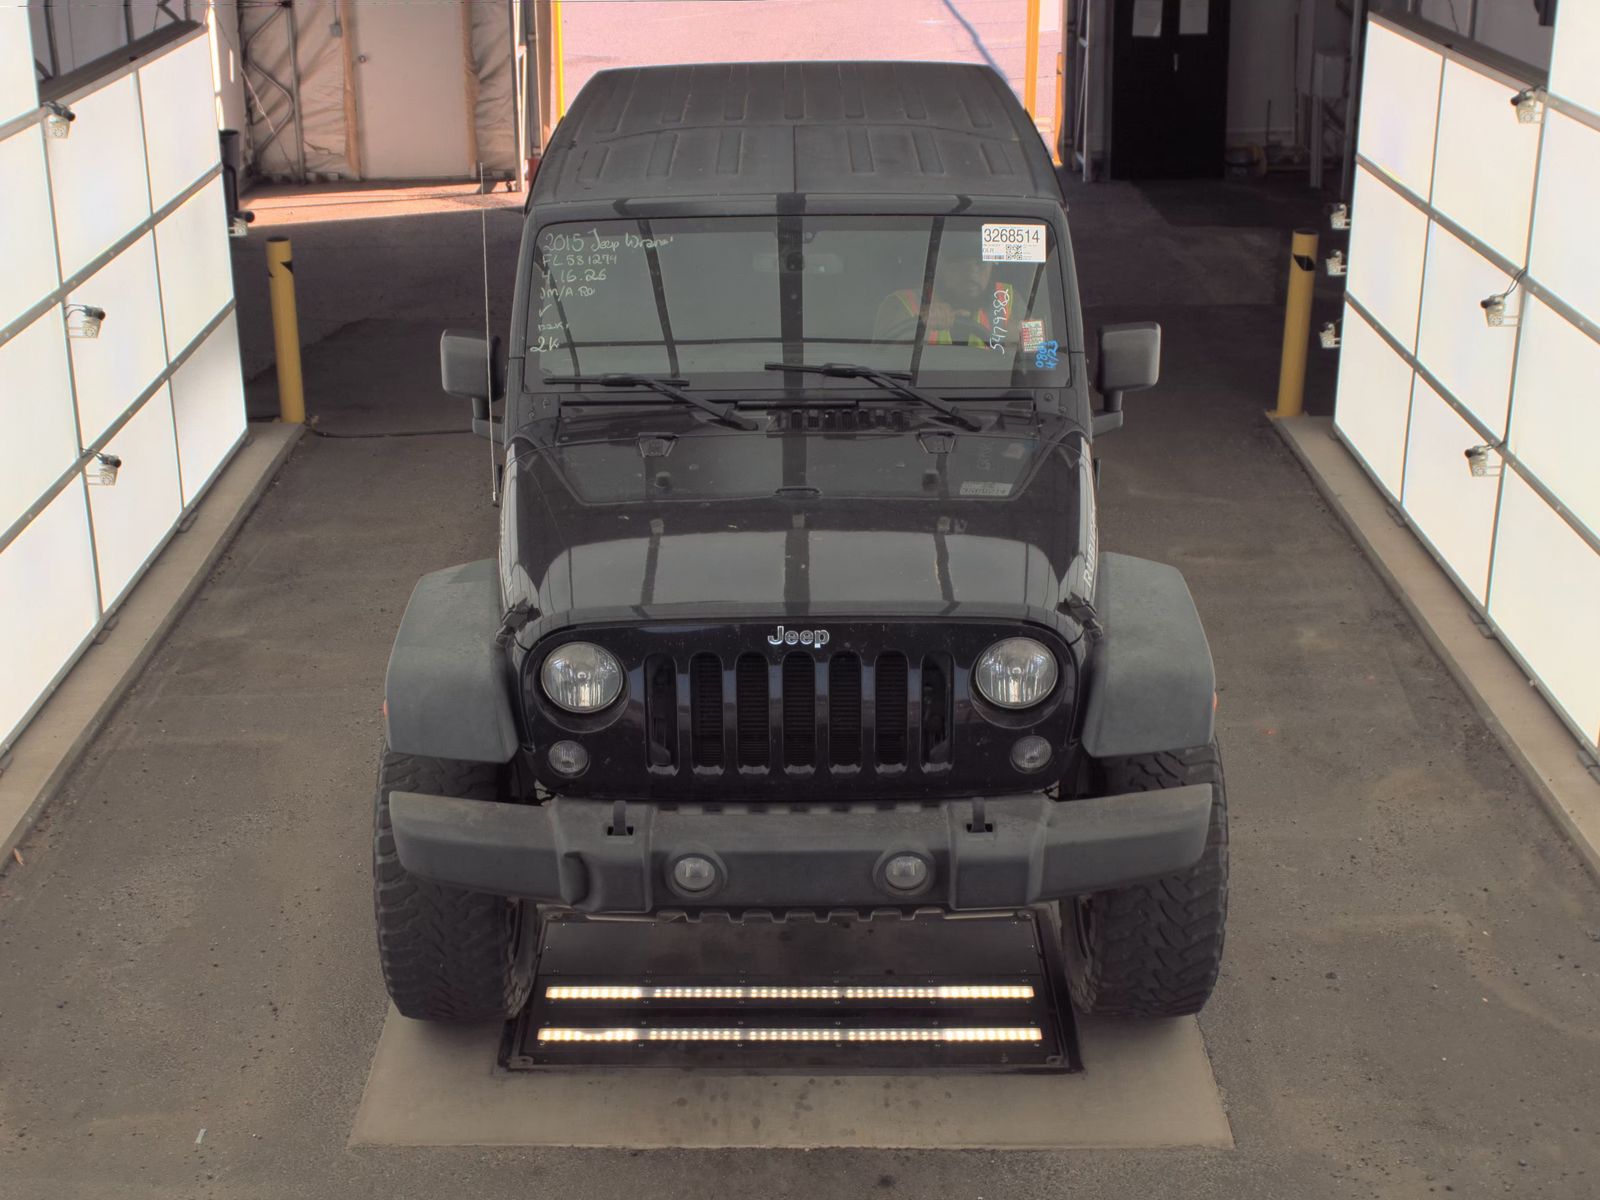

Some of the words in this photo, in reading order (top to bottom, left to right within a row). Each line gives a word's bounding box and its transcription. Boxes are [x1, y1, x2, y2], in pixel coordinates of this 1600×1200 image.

[543, 233, 584, 252] 2015
[587, 228, 619, 252] Jeep
[984, 228, 1040, 243] 3268514
[990, 288, 1010, 354] 5479382
[767, 625, 830, 648] Jeep
